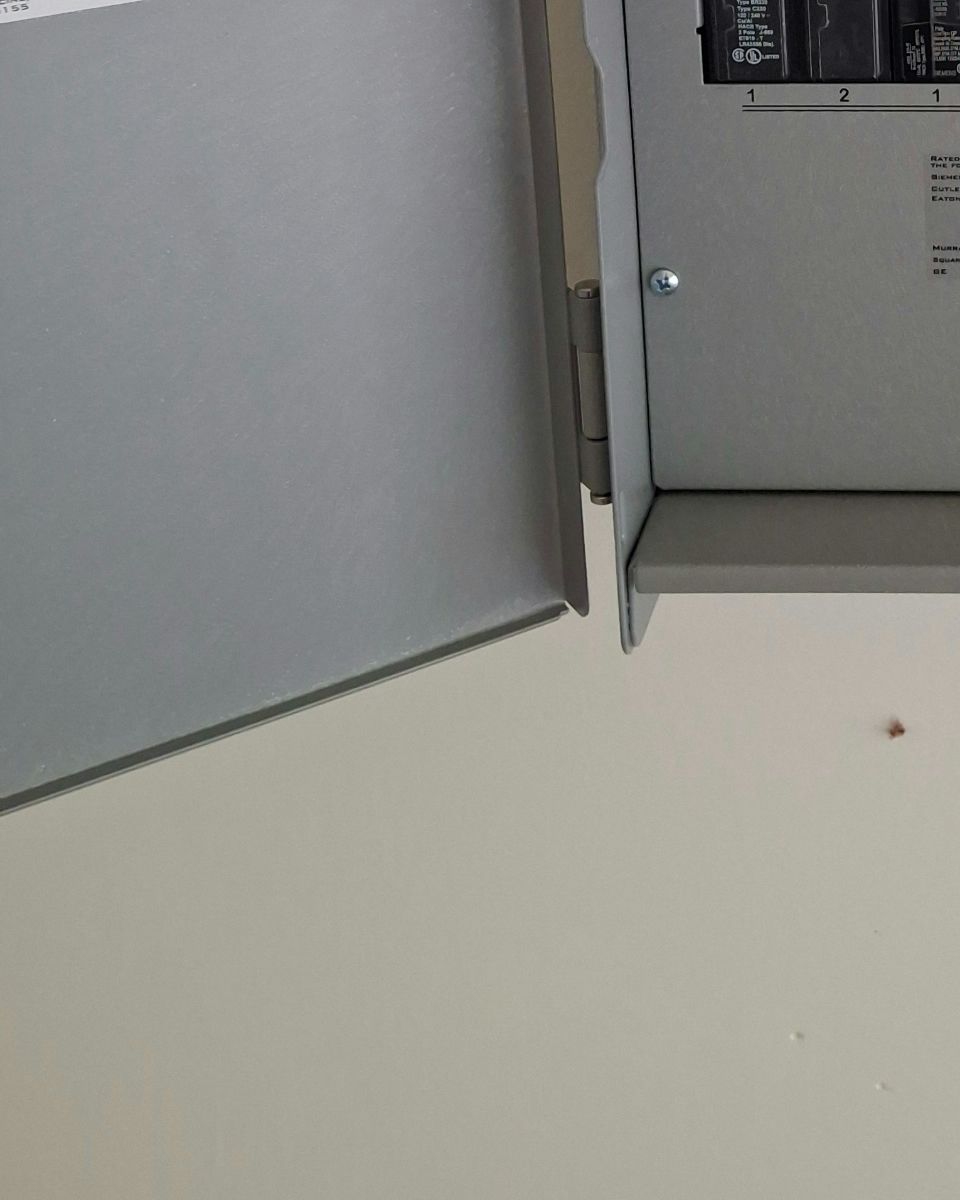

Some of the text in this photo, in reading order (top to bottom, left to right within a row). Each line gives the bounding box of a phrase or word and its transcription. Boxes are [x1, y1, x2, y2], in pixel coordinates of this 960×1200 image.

[747, 89, 755, 102] 1
[839, 89, 849, 102] 2
[932, 89, 940, 102] 1
